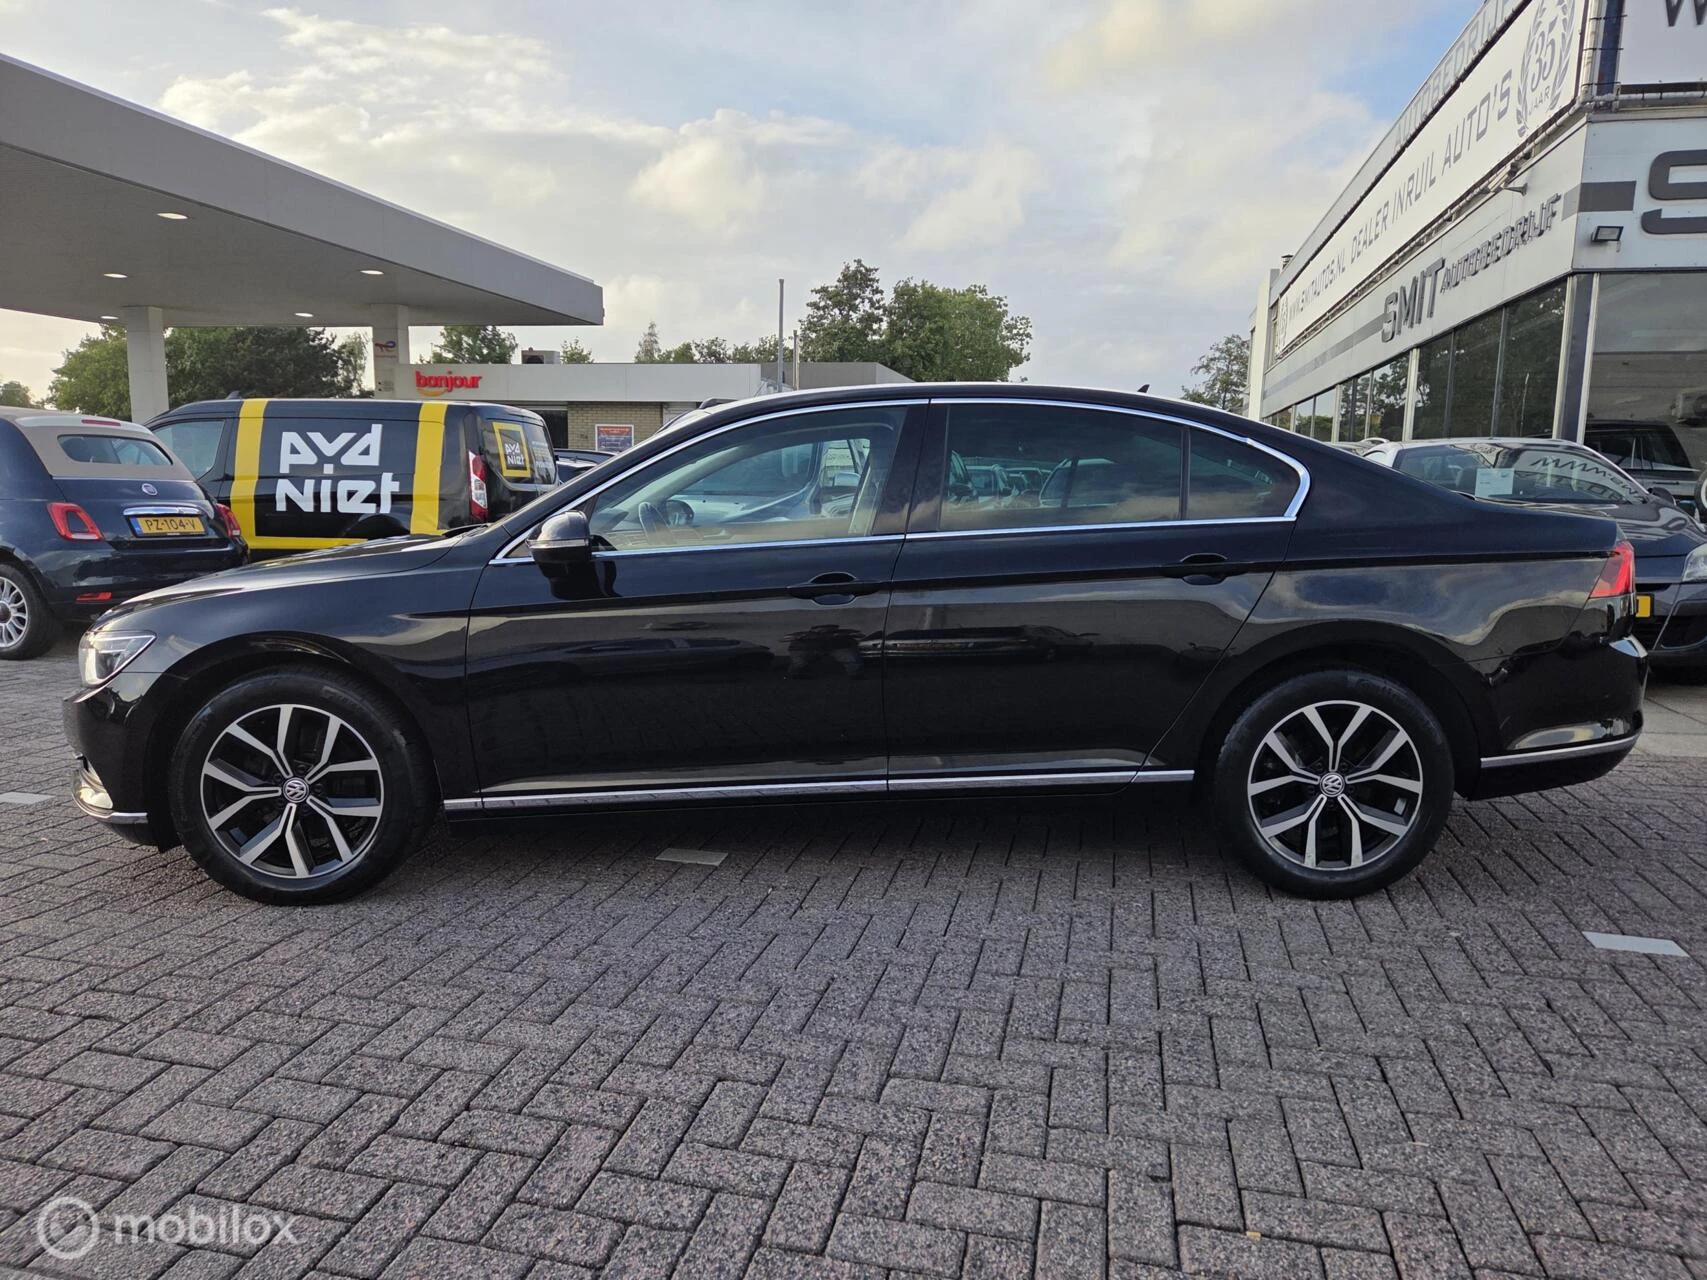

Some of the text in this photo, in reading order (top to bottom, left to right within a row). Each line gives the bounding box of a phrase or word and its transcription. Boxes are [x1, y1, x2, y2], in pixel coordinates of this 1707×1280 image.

[1530, 16, 1558, 92] 35
[1351, 200, 1389, 264] DEALER
[1392, 151, 1436, 224] INRUIL
[1441, 68, 1513, 177] AUTO'S
[1381, 257, 1446, 344] SMIT
[1440, 192, 1562, 294] AUTOBEDRIJF
[415, 369, 481, 393] bonjour
[145, 519, 196, 531] PZ-104-V
